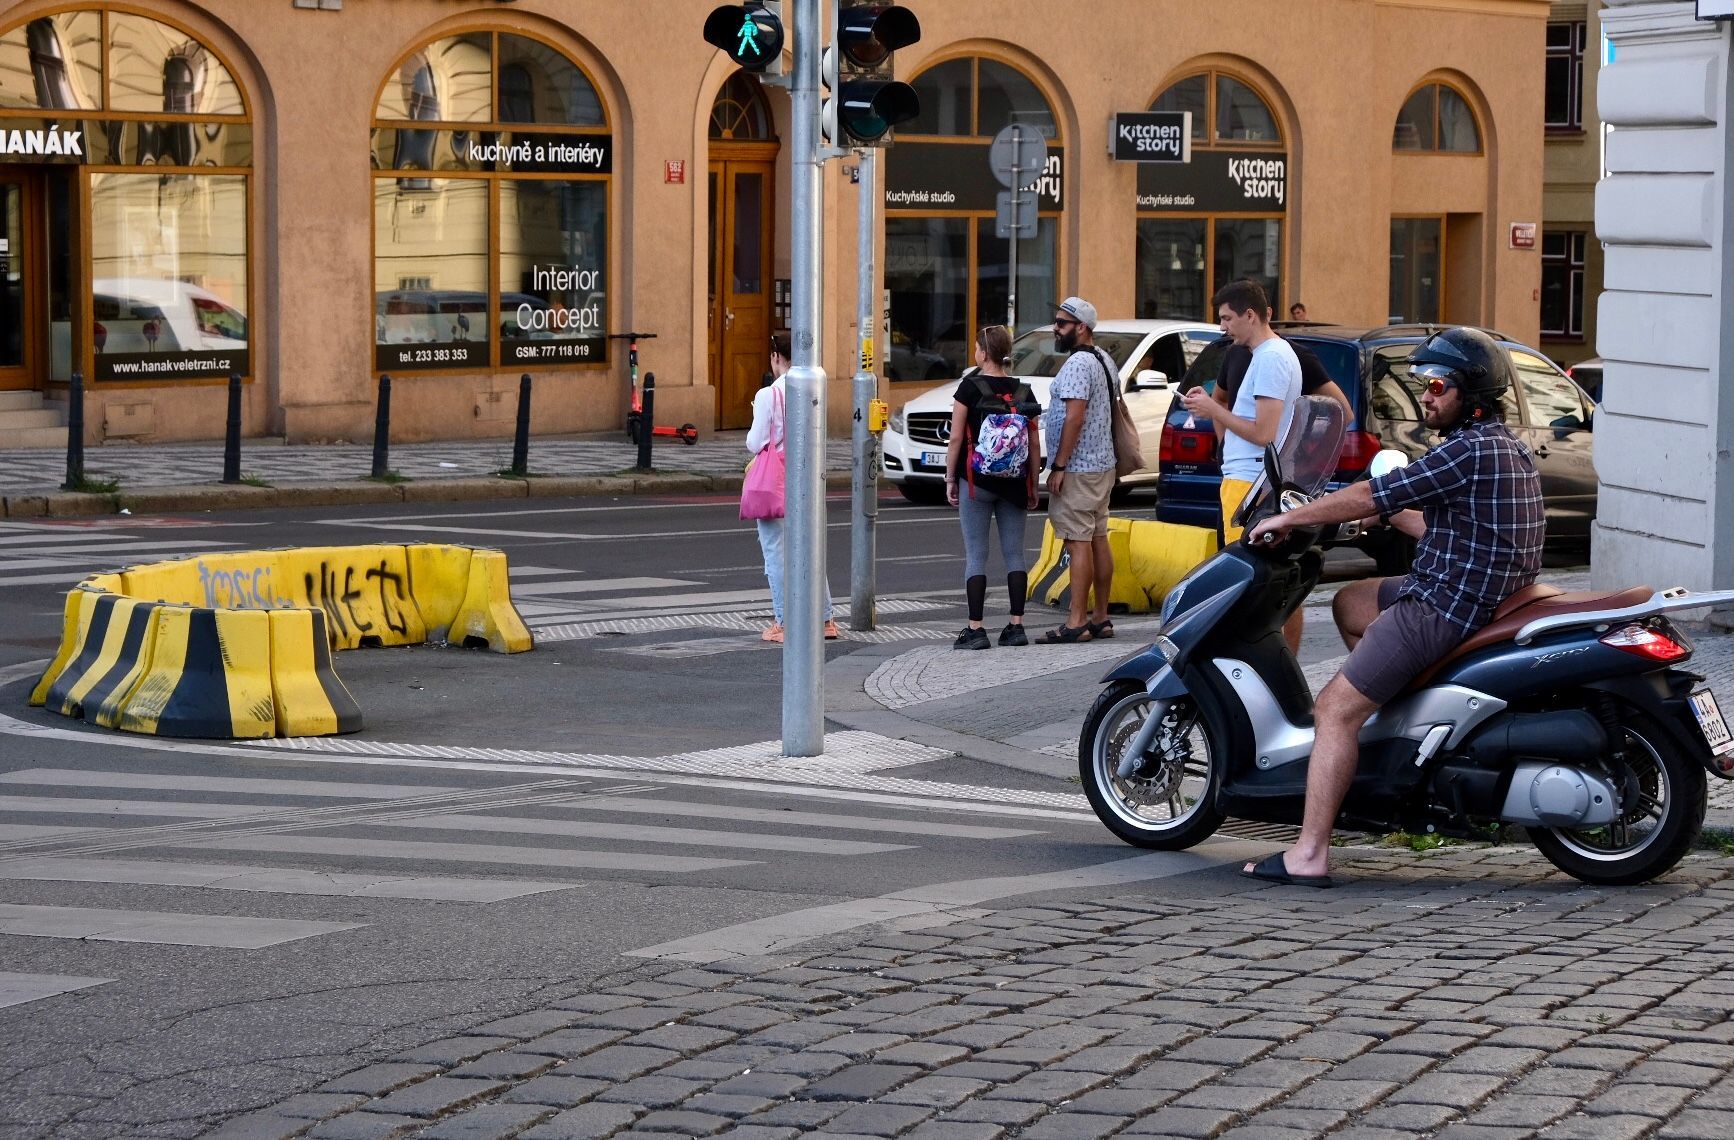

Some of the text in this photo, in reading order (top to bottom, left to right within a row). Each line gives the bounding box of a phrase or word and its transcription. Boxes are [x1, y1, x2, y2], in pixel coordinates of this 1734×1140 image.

[469, 140, 604, 168] kuchyně a interiéry
[1136, 138, 1180, 156] story
[886, 190, 956, 204] Kuchyňské studio
[1019, 176, 1061, 204] ory
[1243, 178, 1284, 205] story
[1136, 194, 1195, 208] Kuchyňské studio
[533, 264, 599, 291] Interior
[516, 303, 599, 334] Concept
[399, 348, 468, 363] tel. 233 383 353
[516, 345, 589, 358] GSM: 777 118 019
[112, 357, 231, 373] www.hanakveletrzni.cz
[1702, 718, 1726, 742] 6802
